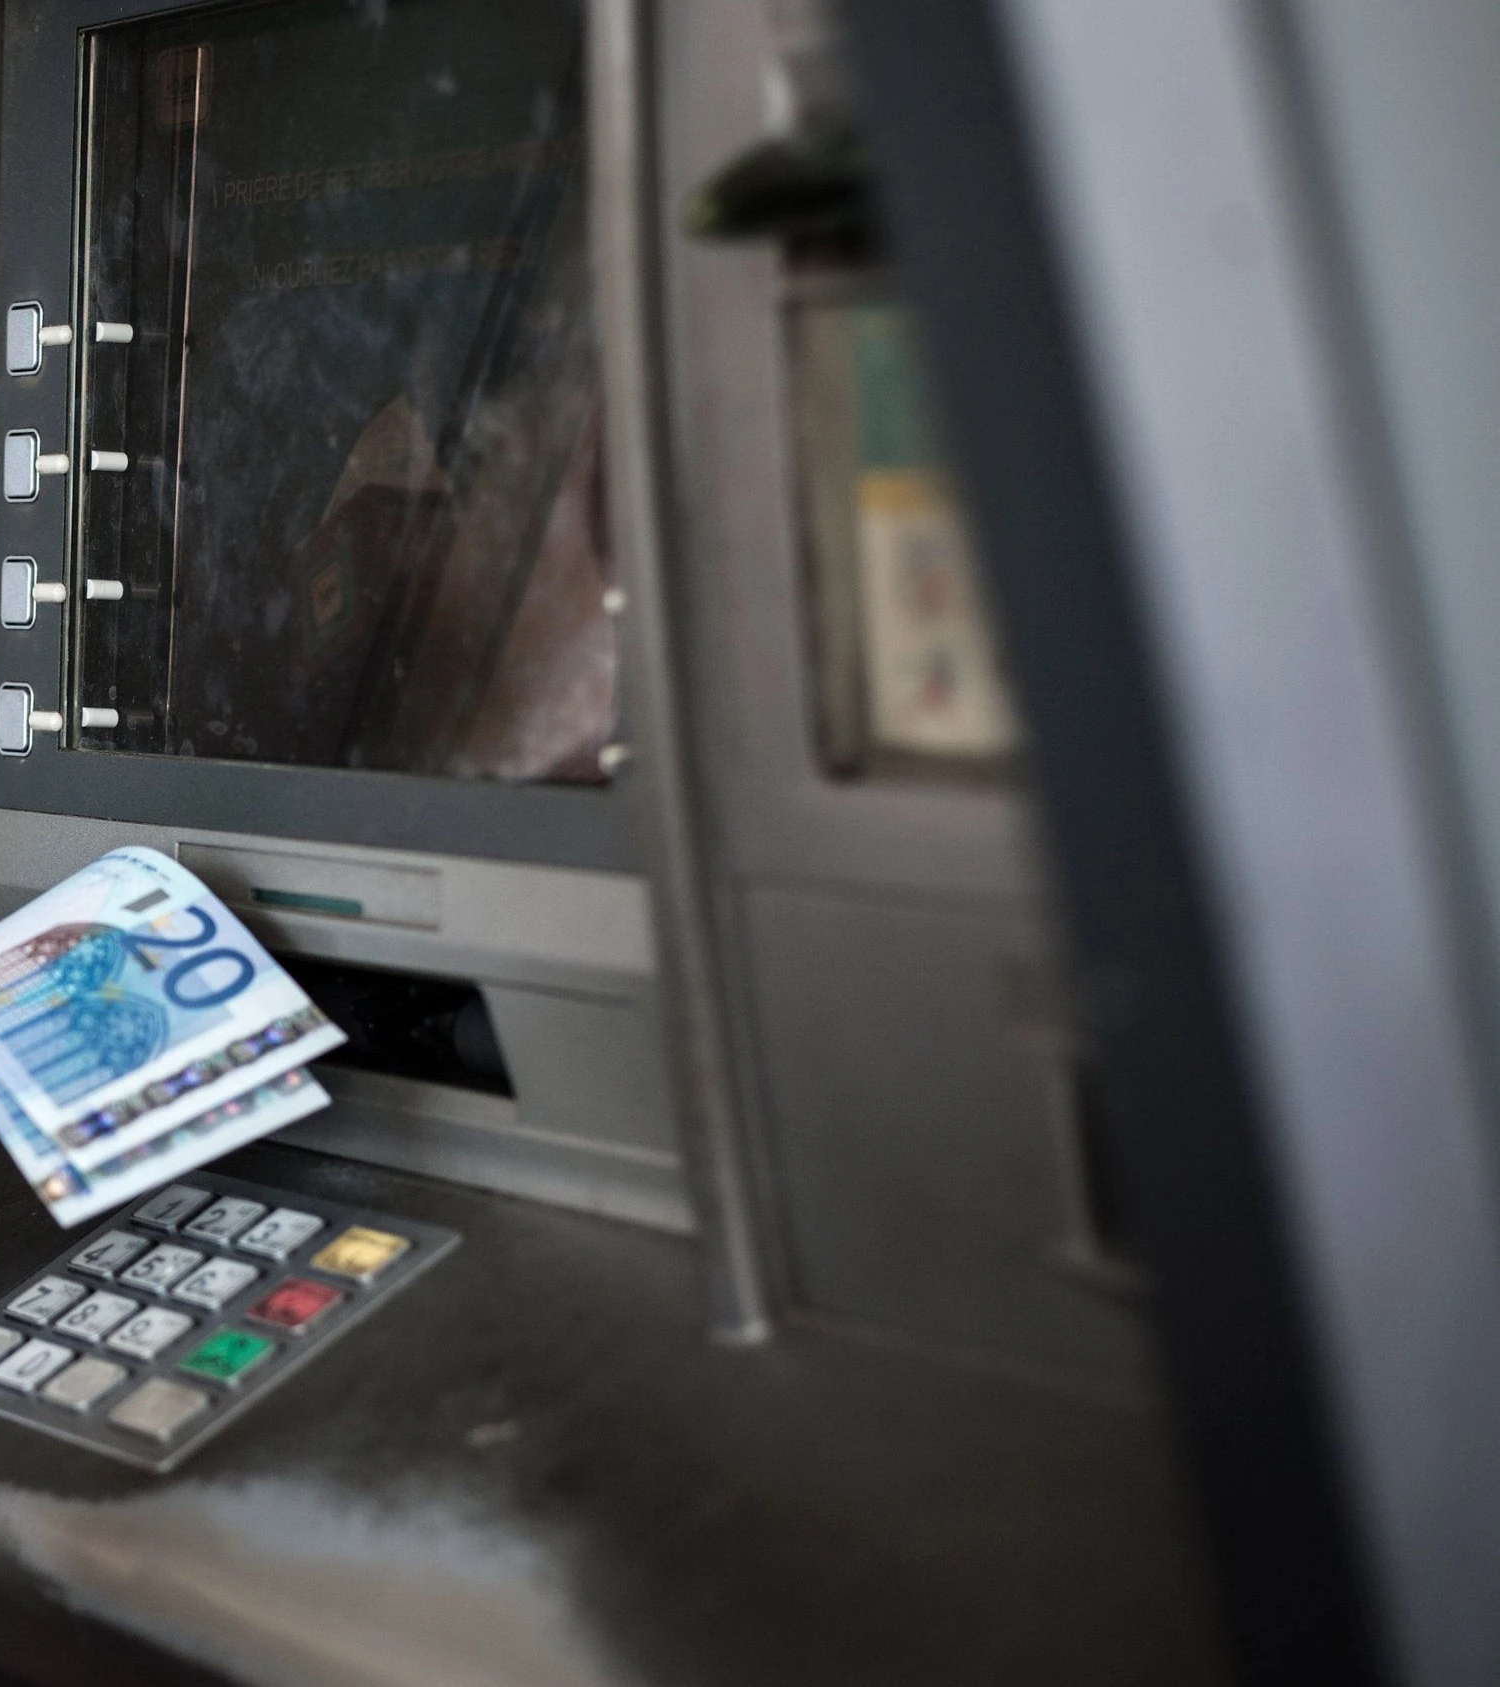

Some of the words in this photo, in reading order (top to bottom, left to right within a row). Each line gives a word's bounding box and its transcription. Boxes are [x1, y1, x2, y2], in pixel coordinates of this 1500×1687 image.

[296, 169, 322, 200] DE
[119, 905, 255, 1010] 20
[155, 1199, 187, 1220] 1
[193, 1208, 227, 1231] 2
[248, 1222, 279, 1243] 3
[83, 1243, 115, 1264] 4
[131, 1255, 165, 1279] 5
[184, 1270, 217, 1293] 6
[16, 1285, 52, 1308] 7
[67, 1303, 100, 1326] 8
[119, 1319, 151, 1342] 9
[16, 1350, 52, 1378] 0
